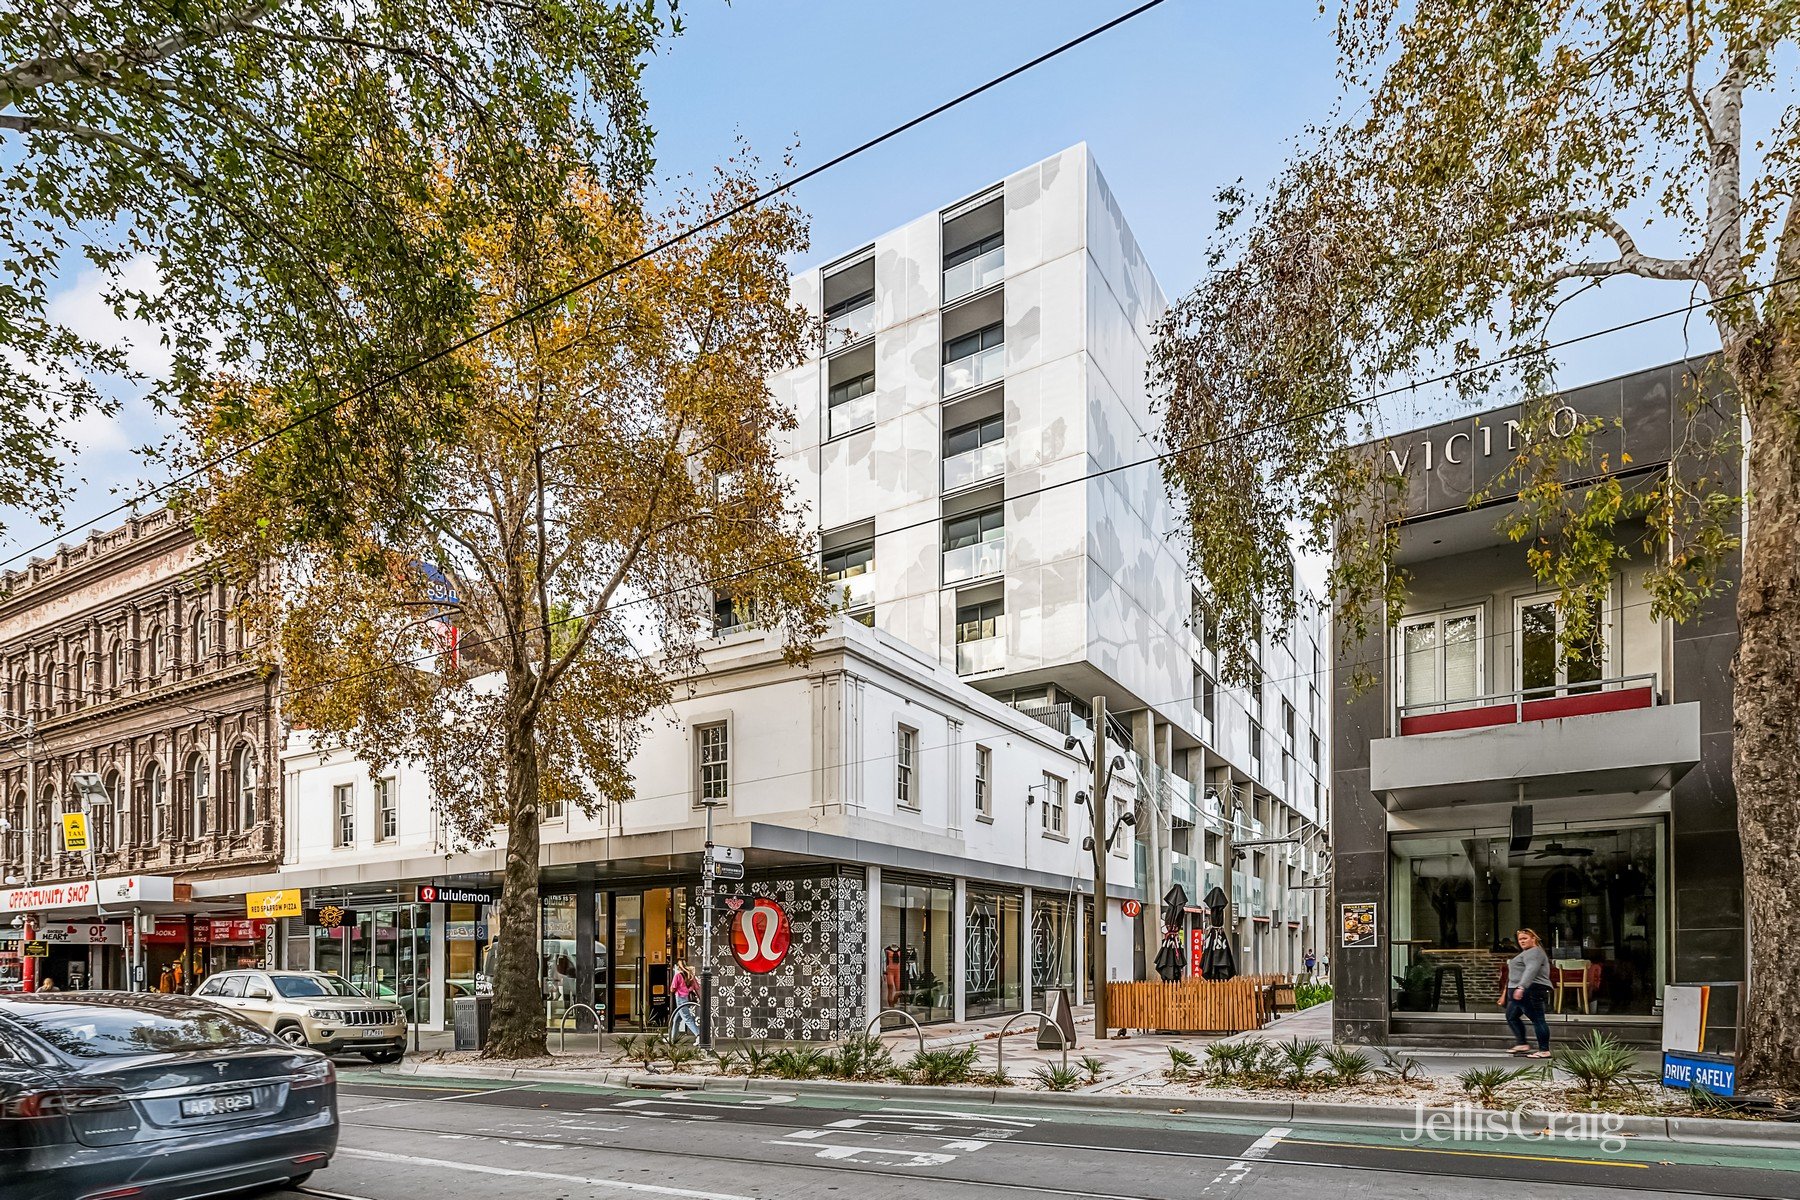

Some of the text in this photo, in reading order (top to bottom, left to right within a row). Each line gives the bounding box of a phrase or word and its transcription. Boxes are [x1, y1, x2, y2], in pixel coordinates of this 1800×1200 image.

[1386, 406, 1578, 477] VICINO
[9, 884, 90, 909] OPPORTUNITY SHOP
[439, 889, 490, 903] lululemon
[261, 904, 283, 912] SPARROW
[283, 903, 297, 911] PIZZA
[42, 933, 68, 941] HEART
[89, 926, 106, 937] OP
[1665, 1063, 1733, 1089] DRIVE SAFELY
